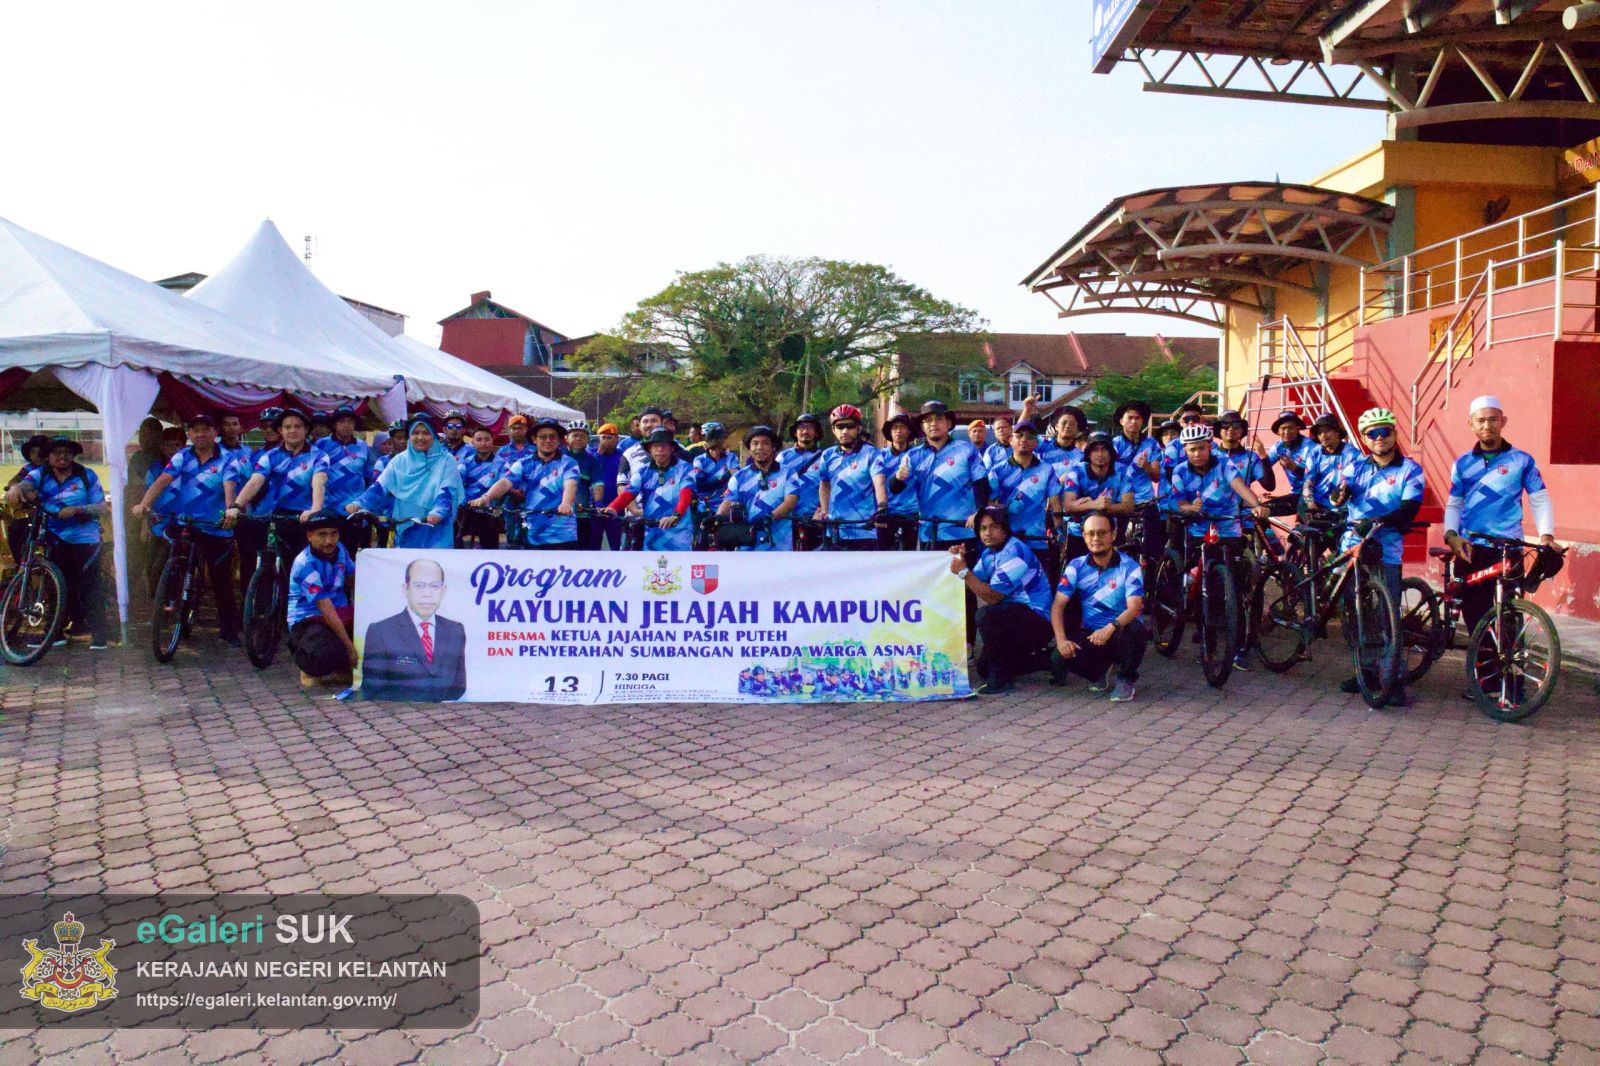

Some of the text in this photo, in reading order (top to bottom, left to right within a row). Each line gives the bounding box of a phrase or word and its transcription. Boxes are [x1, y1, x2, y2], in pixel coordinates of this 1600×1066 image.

[470, 561, 627, 606] Program
[487, 599, 923, 629] KAYUHAN JELAJAH KAMPUNG
[487, 630, 788, 644] BERSAMA KETUA JAJAHAN PASIR PUTEH
[487, 644, 925, 658] DAN PENYERAHAN SUMBANGAN KEPADA WARGA ASNAF
[544, 675, 580, 693] 13
[615, 673, 670, 681] 7.30 PAGI
